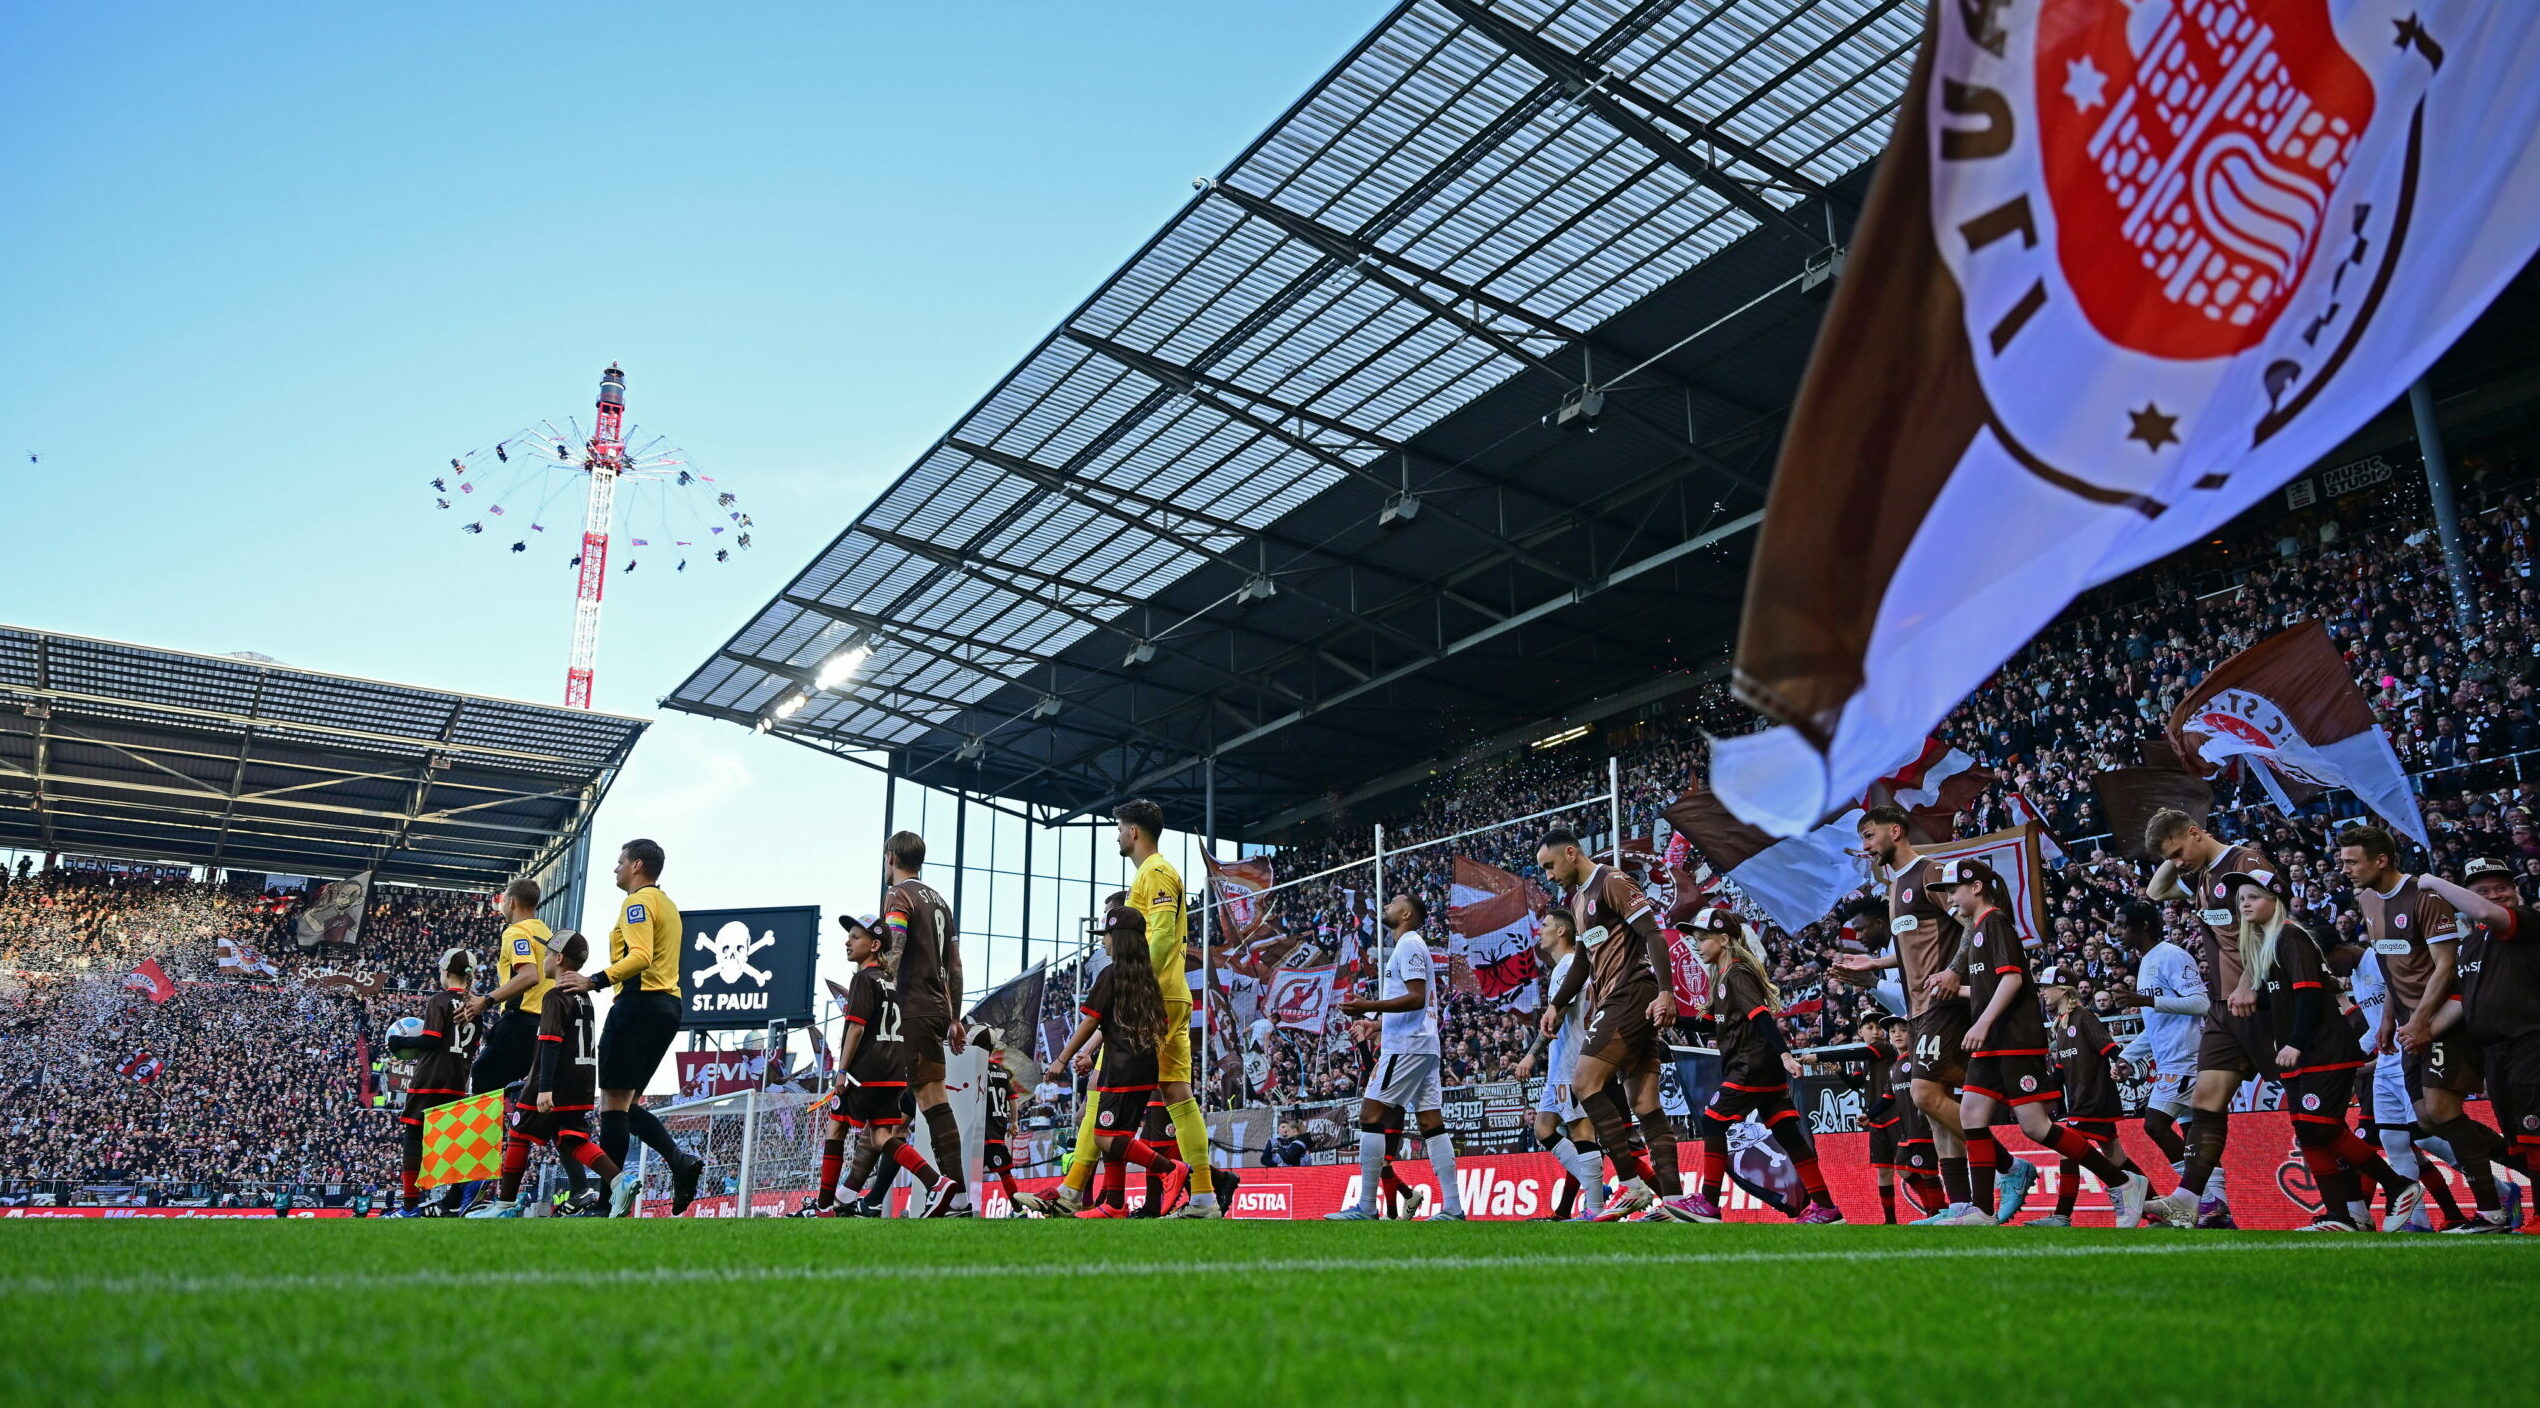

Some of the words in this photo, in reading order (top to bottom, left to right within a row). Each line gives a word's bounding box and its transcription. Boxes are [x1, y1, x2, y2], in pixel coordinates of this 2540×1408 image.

[2324, 456, 2383, 485] MUSIC
[2378, 942, 2408, 953] congstar
[692, 993, 715, 1012] ST.
[716, 992, 769, 1011] PAULI
[875, 1000, 905, 1042] 12
[1588, 1010, 1605, 1033] 2
[448, 1021, 477, 1055] 12
[1915, 1034, 1942, 1061] 44
[2431, 1042, 2445, 1067] 5
[1488, 1116, 1520, 1128] ETERNO
[1236, 1192, 1288, 1211] ASTRA
[1456, 1167, 1540, 1217] Was
